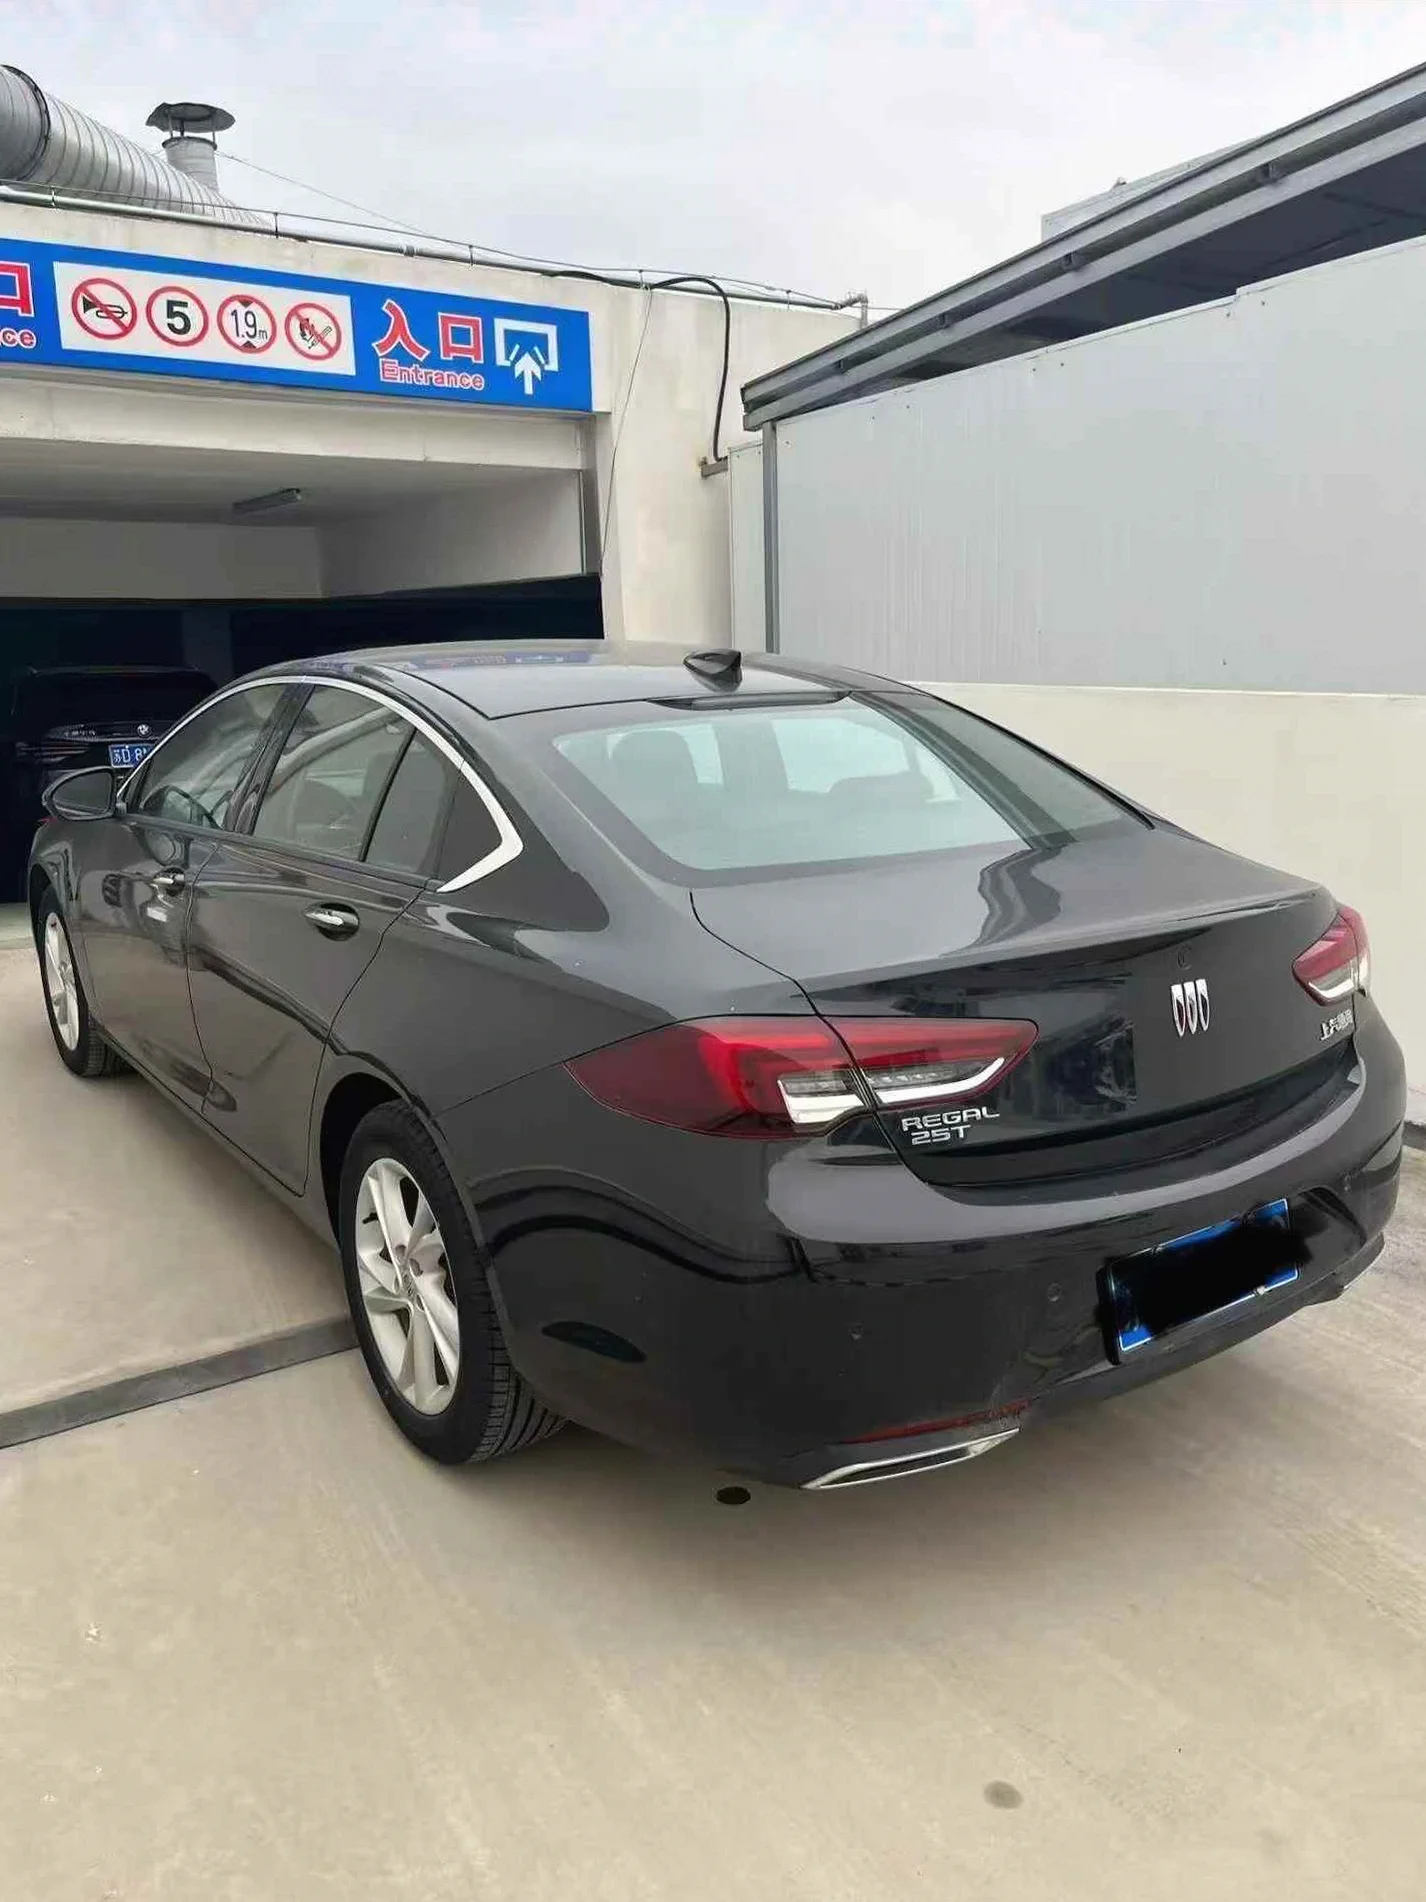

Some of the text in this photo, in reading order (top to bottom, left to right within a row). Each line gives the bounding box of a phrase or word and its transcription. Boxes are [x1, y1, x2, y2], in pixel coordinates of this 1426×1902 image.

[166, 299, 192, 336] 5
[230, 308, 268, 341] 1.9m
[372, 298, 484, 364] 入口
[380, 357, 485, 391] Entrance
[901, 1106, 1000, 1131] REGAL
[911, 1124, 971, 1145] 25T
